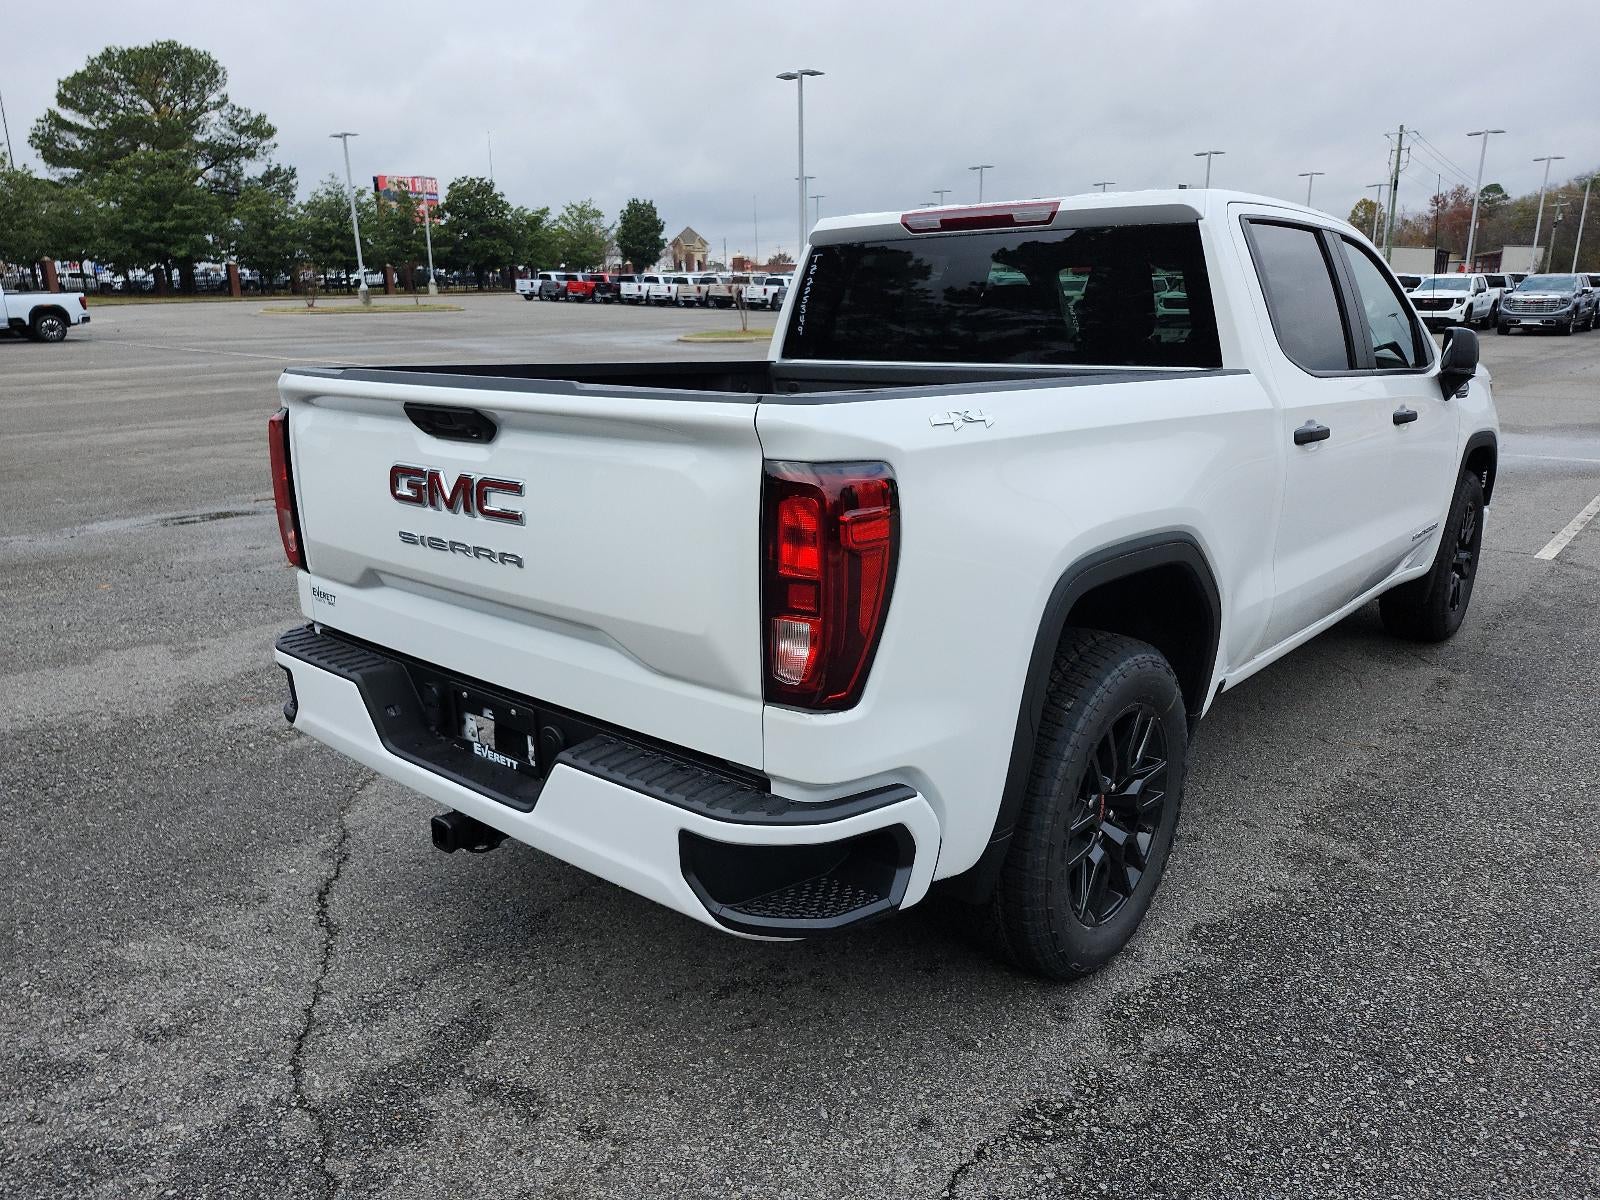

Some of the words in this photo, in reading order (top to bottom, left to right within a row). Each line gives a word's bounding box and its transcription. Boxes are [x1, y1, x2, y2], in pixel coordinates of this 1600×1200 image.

[389, 461, 527, 527] GMC
[398, 530, 525, 569] SIERRA
[473, 741, 519, 770] EVERETT
